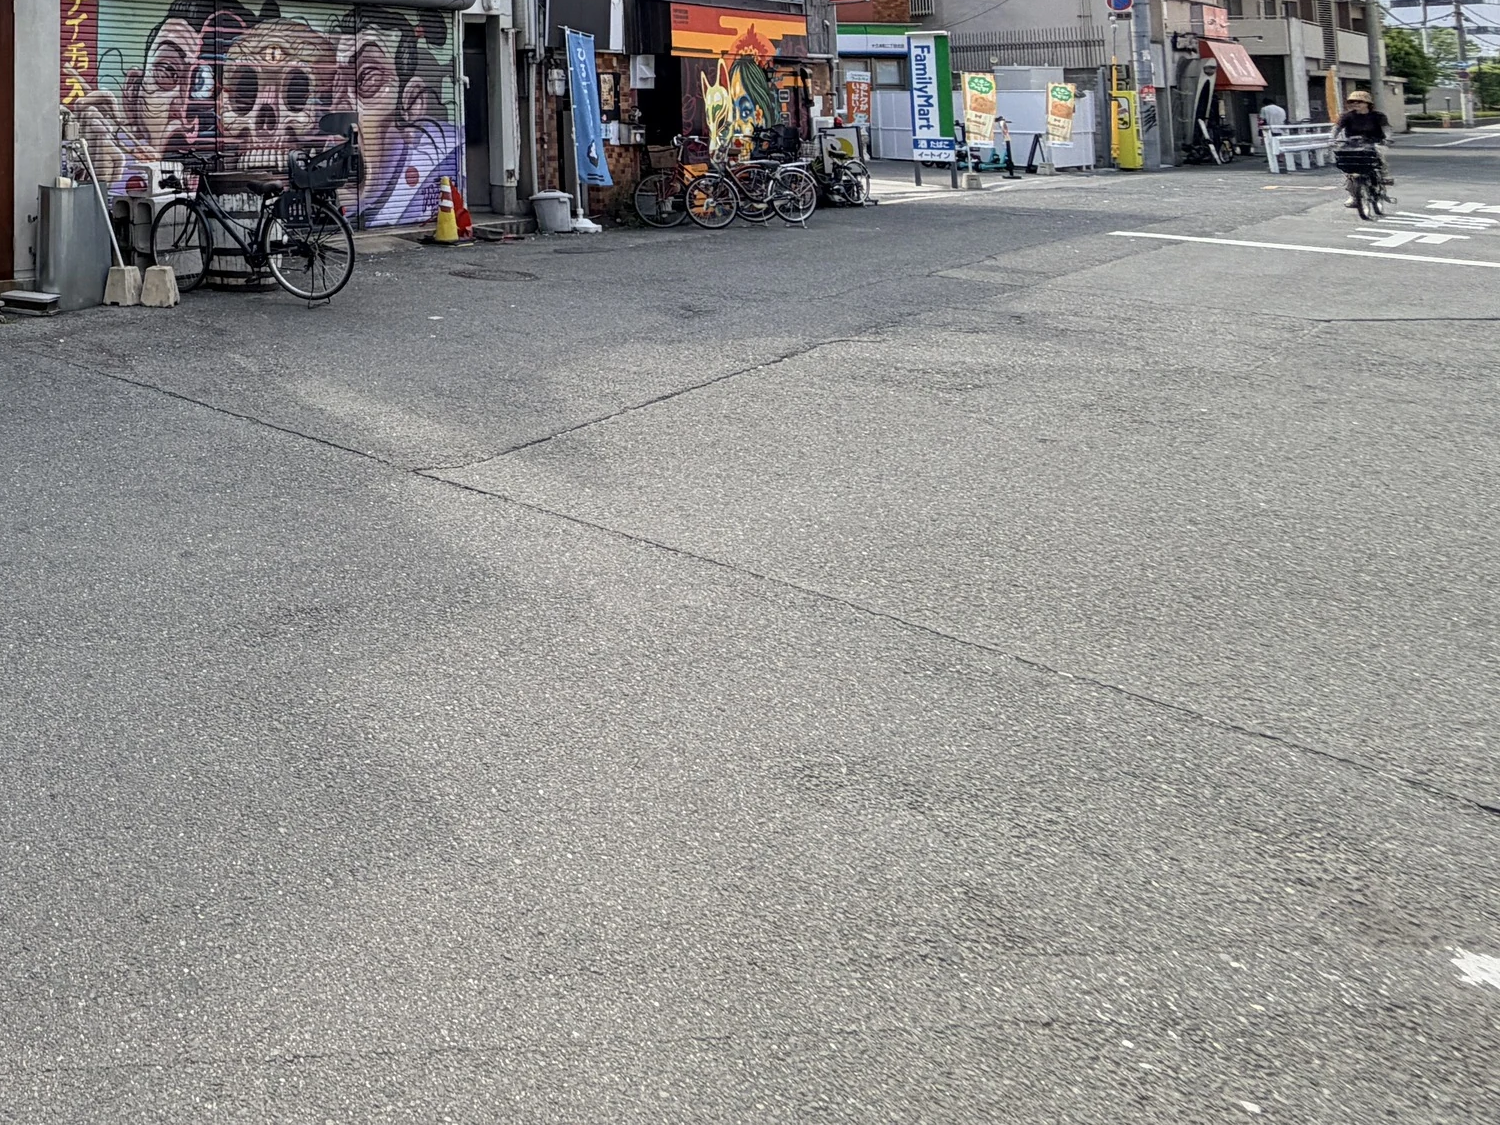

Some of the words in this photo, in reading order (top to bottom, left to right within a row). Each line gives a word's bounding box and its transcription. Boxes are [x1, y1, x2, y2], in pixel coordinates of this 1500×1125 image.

[913, 44, 935, 131] FamilyMart
[918, 140, 927, 148] 酒
[930, 140, 950, 149] たばこ
[918, 151, 951, 160] イートイン
